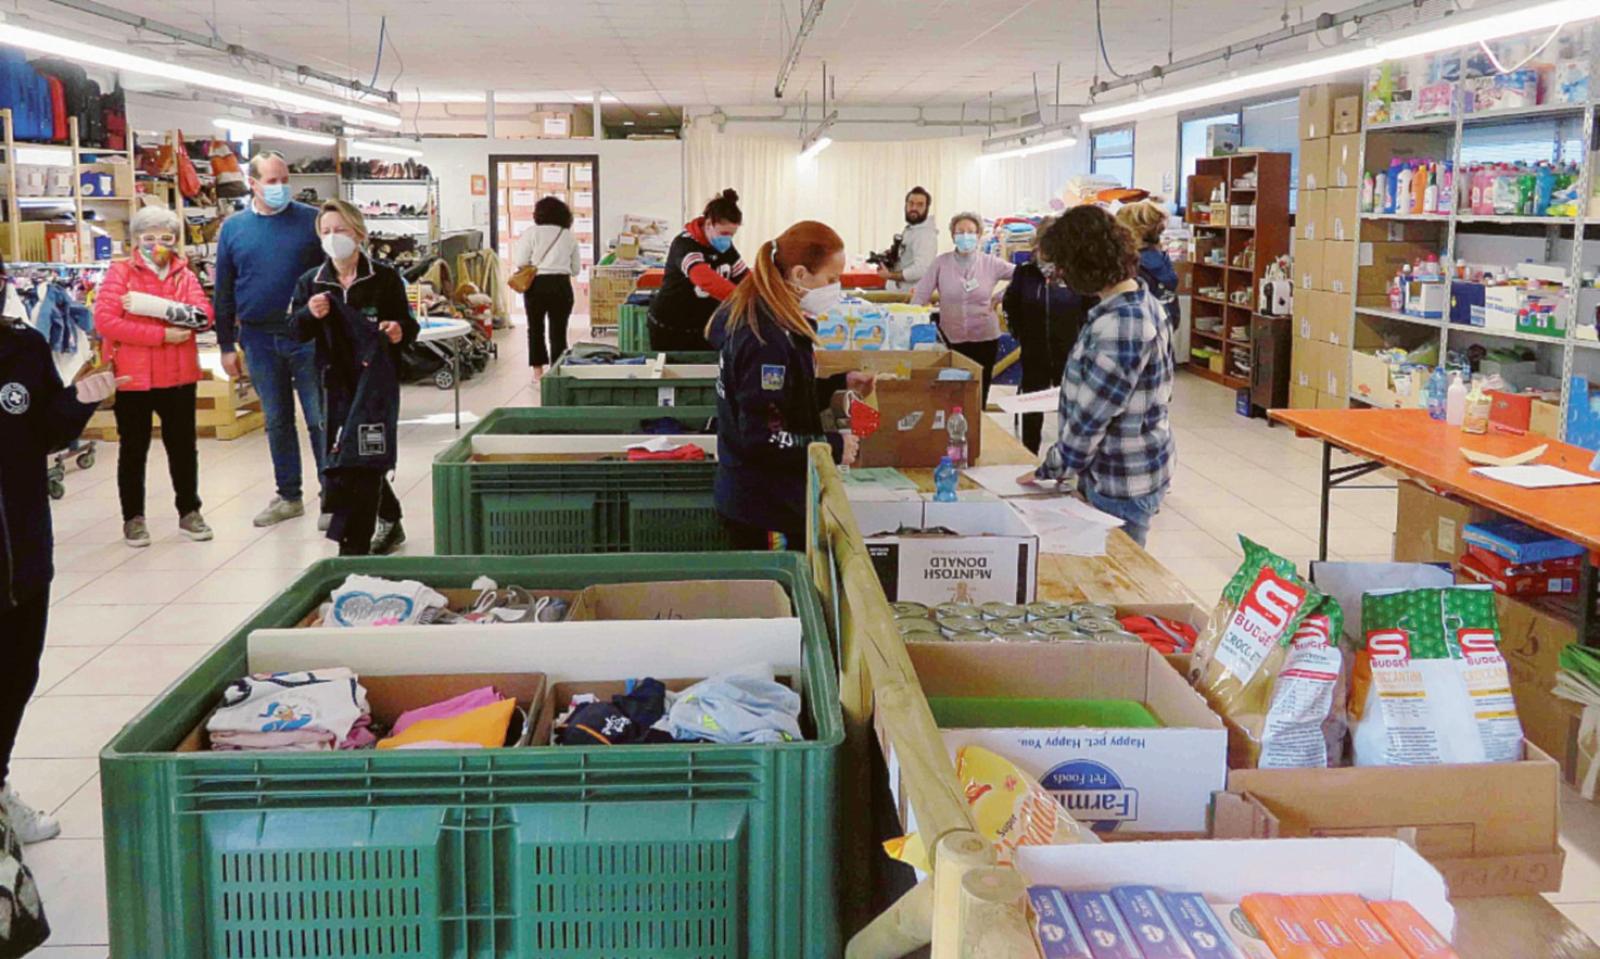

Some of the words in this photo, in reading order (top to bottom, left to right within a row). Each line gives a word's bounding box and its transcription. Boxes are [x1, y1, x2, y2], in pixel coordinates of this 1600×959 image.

[930, 557, 987, 567] DONALD
[924, 568, 992, 580] McINTOSH
[1234, 613, 1273, 646] BUDGE
[1372, 659, 1409, 668] BUDGET
[1467, 655, 1504, 665] BUDGE
[1018, 738, 1042, 749] You.
[1045, 736, 1081, 749] Happy
[1111, 737, 1145, 749] Happy
[1053, 774, 1086, 785] Foods
[1089, 774, 1107, 785] Pet
[1052, 794, 1129, 816] Farmi
